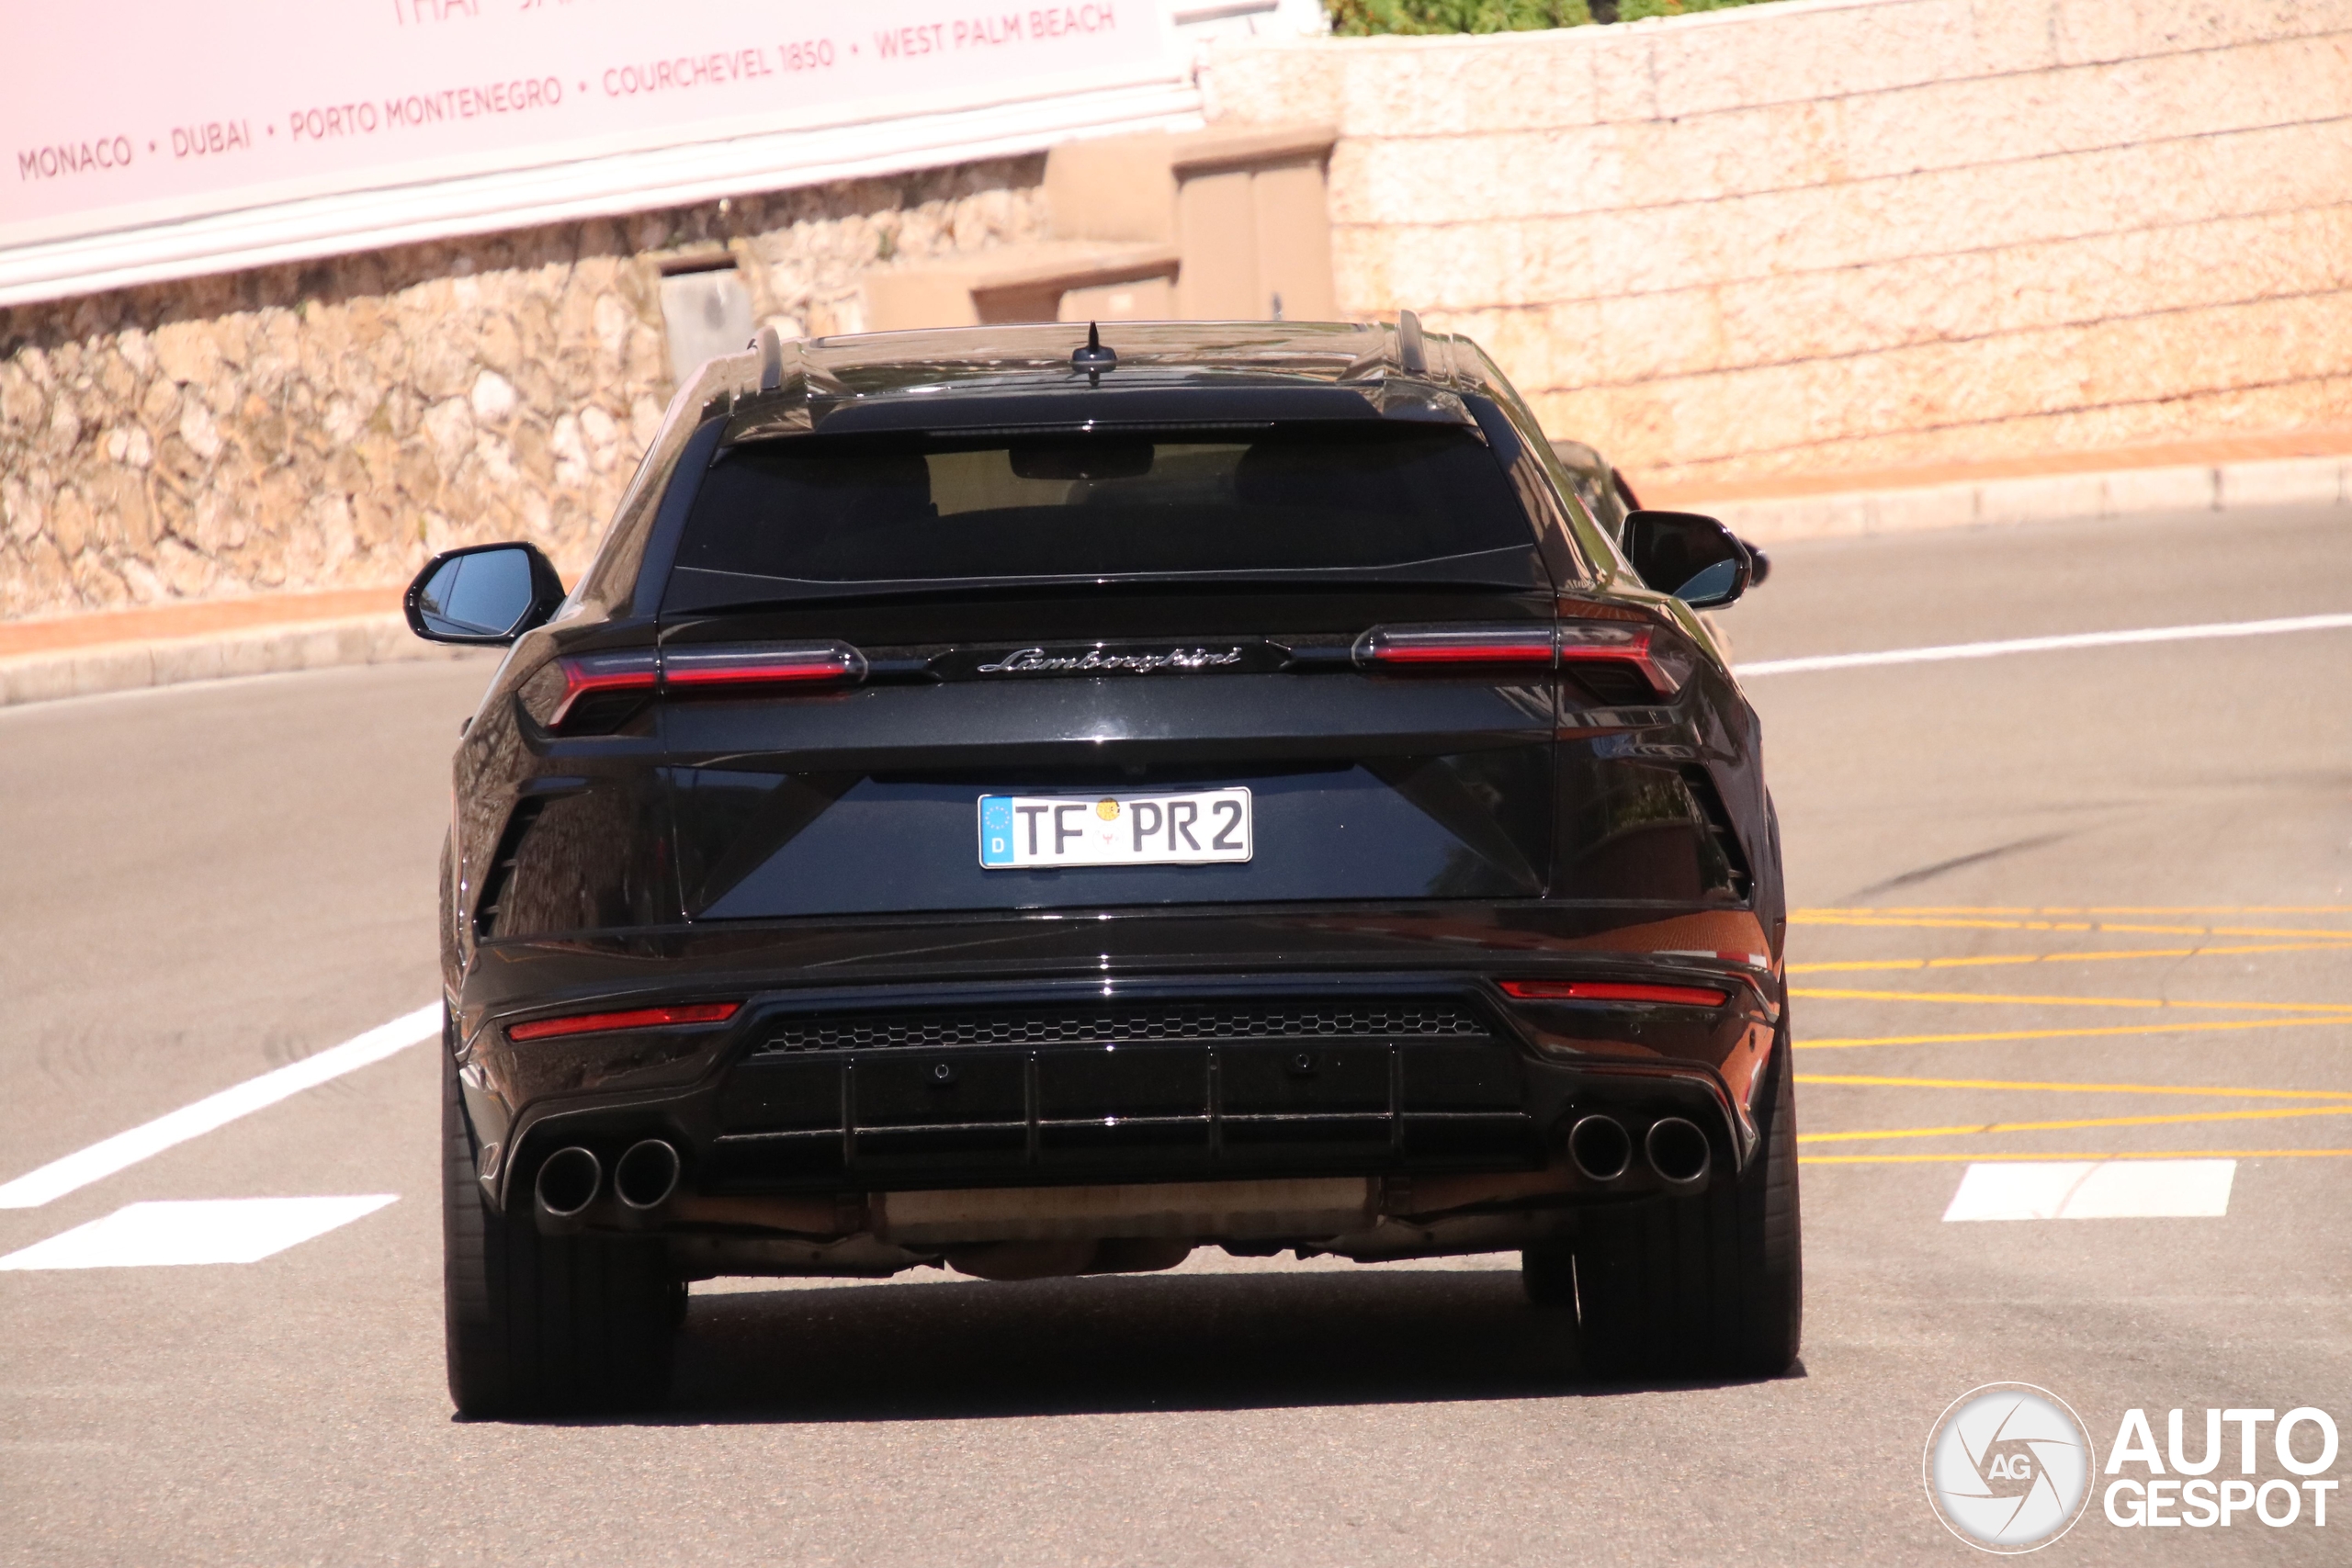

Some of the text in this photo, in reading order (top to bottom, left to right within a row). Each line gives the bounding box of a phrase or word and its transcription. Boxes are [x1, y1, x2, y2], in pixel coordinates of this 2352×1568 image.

[17, 3, 1115, 181] MONACO DUBAI PORTO MONTENEGRO COURCHEVEL 1850 WEST PALM BEACH
[978, 648, 1242, 672] Lamborghini
[992, 837, 1005, 853] D
[1015, 804, 1087, 855] TF
